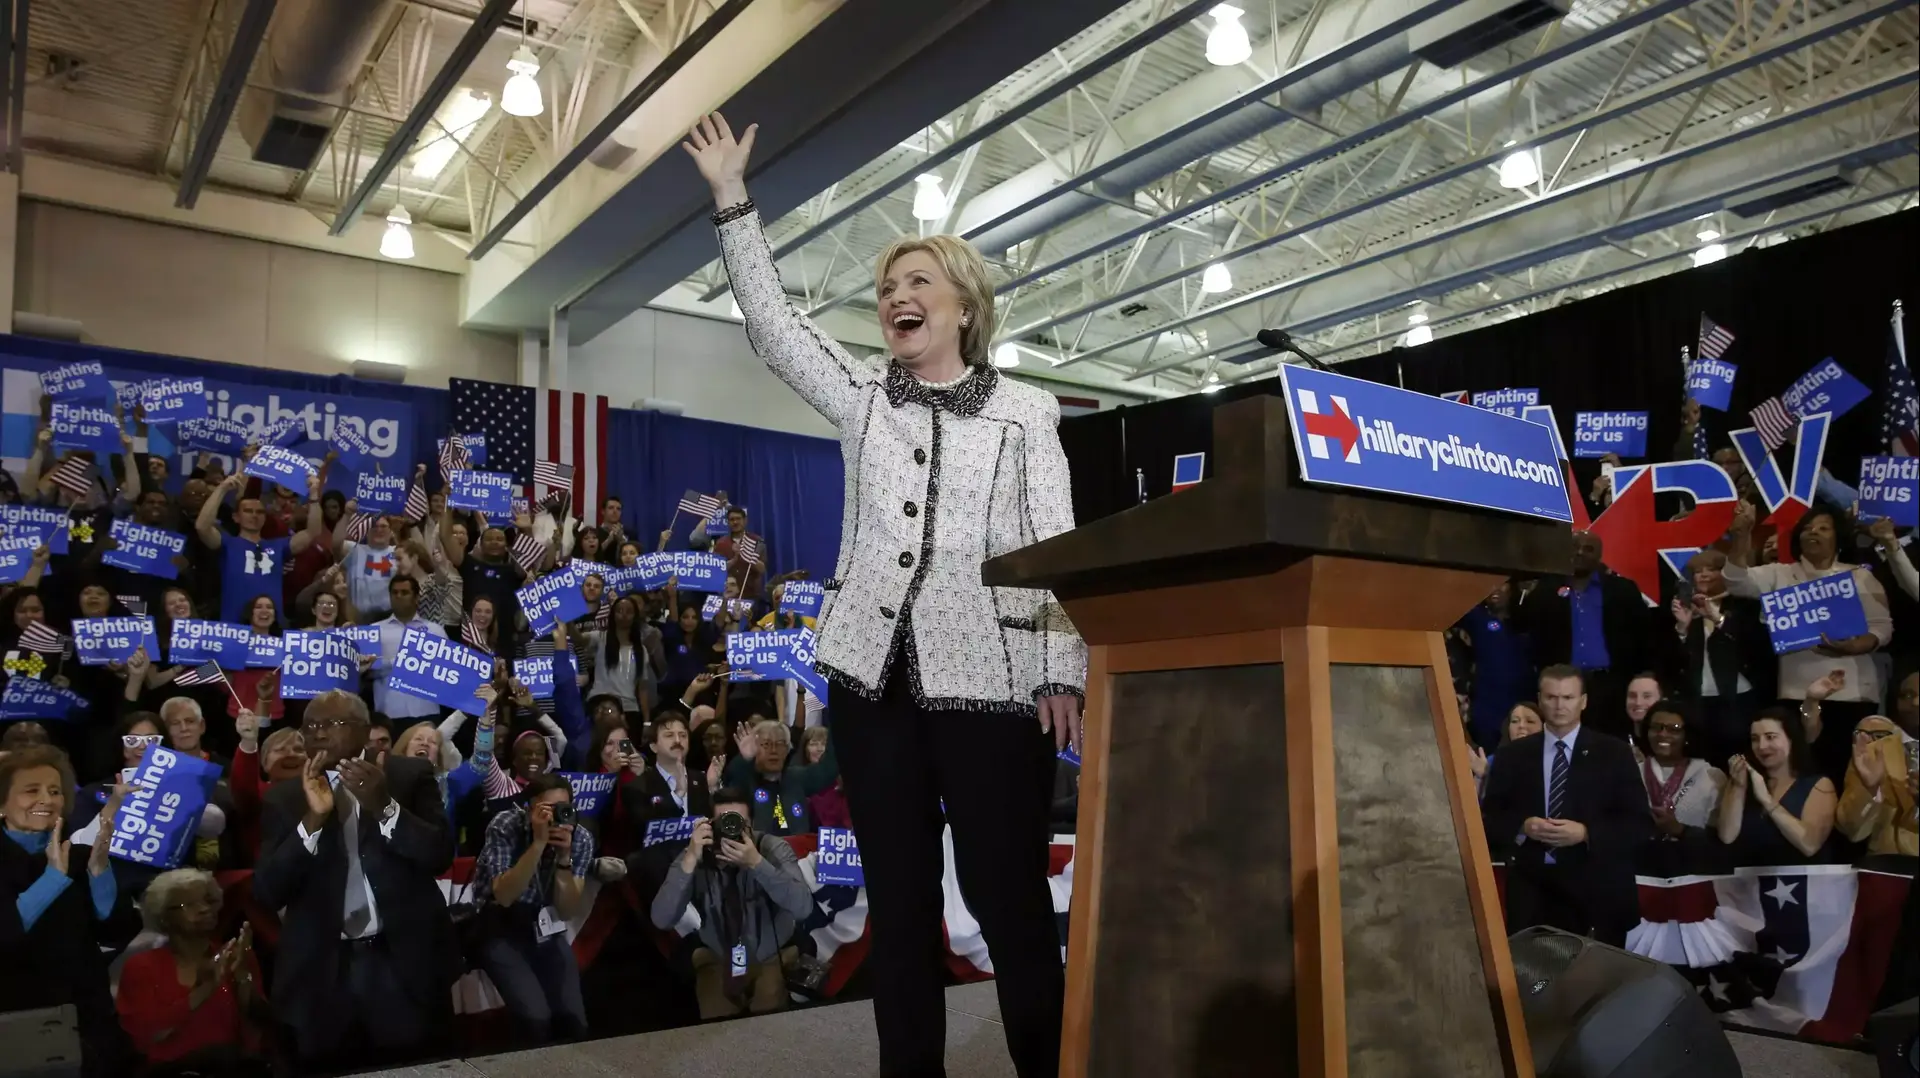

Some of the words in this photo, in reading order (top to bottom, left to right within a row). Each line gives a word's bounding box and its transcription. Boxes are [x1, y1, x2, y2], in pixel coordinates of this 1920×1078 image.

[40, 362, 103, 386] Fighting
[1690, 377, 1711, 389] us
[67, 378, 86, 390] us
[164, 397, 184, 410] us
[1473, 388, 1538, 407] Fighting
[1806, 391, 1831, 411] us
[51, 403, 120, 428] Fighting
[1576, 412, 1648, 430] Fighting
[50, 419, 75, 433] for
[80, 425, 102, 436] us
[1574, 427, 1602, 442] for
[1603, 429, 1623, 442] us
[215, 433, 231, 444] us
[1357, 415, 1560, 488] hillaryclinton.com
[251, 453, 275, 468] for
[274, 463, 294, 475] us
[358, 472, 406, 491] Fighting
[1859, 479, 1881, 501] for
[1883, 486, 1912, 502] us
[356, 486, 374, 500] for
[375, 491, 394, 502] us
[472, 488, 490, 498] us
[111, 520, 184, 552] Fighting
[136, 544, 158, 560] us
[674, 552, 728, 571] Fighting
[640, 567, 658, 580] for
[674, 564, 693, 576] for
[695, 568, 712, 578] us
[516, 571, 575, 607] Fighting
[619, 582, 633, 592] us
[784, 580, 824, 596] Fightin
[1761, 577, 1856, 615] Fighting
[781, 592, 799, 603] for
[800, 596, 815, 605] us
[524, 605, 542, 622] for
[541, 596, 560, 612] us
[73, 618, 153, 636] Fighting
[1766, 611, 1801, 633] for
[1804, 606, 1831, 624] us
[173, 619, 250, 644] Fighting
[75, 636, 104, 650] for
[108, 636, 130, 648] us
[170, 634, 196, 650] for
[201, 640, 223, 652] us
[254, 647, 276, 656] us
[285, 632, 360, 672] Fighting
[402, 628, 492, 679] Fighting
[727, 651, 755, 666] for
[757, 651, 778, 664] us
[791, 641, 816, 667] for
[282, 654, 321, 676] for
[325, 662, 349, 681] us
[396, 649, 431, 675] for
[433, 665, 460, 686] us
[2, 689, 32, 705] for
[35, 695, 57, 706] us
[109, 748, 177, 857] Fighting
[577, 796, 596, 811] us
[129, 827, 165, 863] for
[154, 791, 182, 823] us
[820, 829, 857, 852] Figh
[818, 846, 844, 866] for
